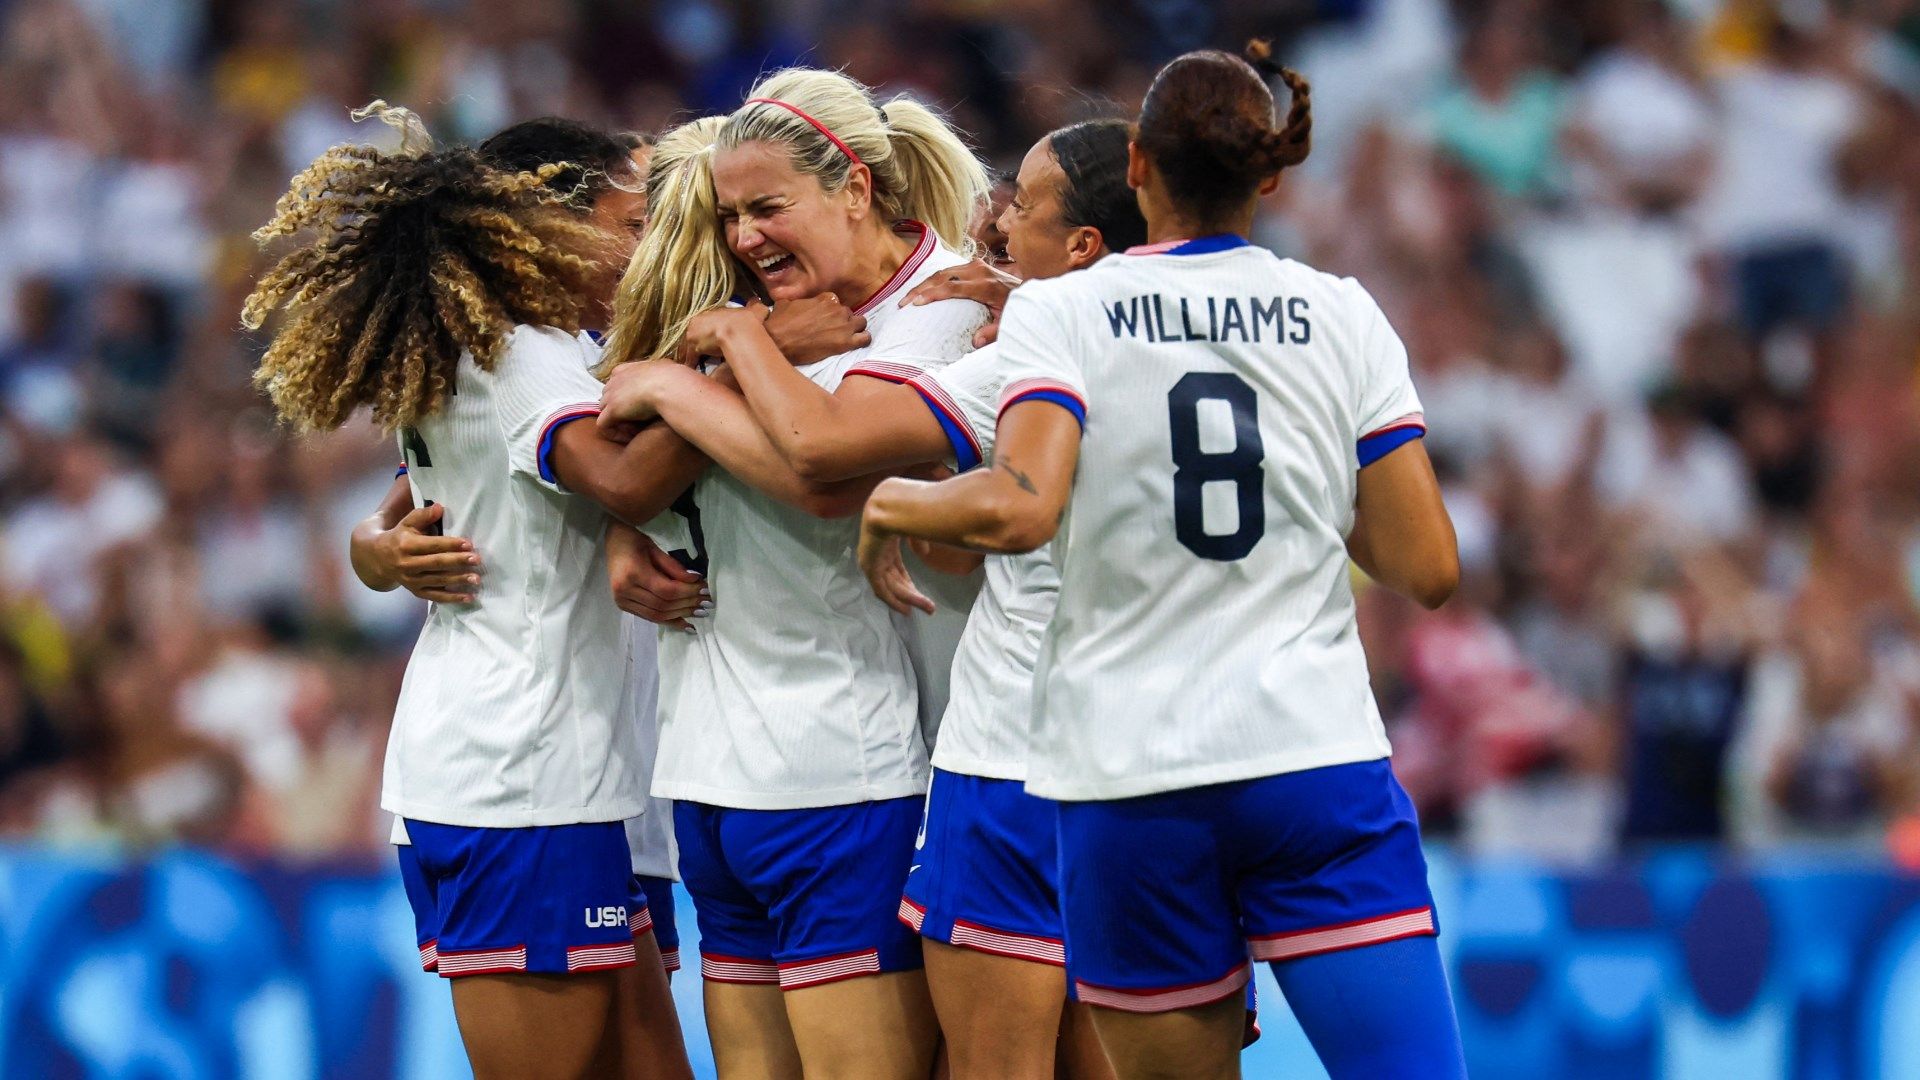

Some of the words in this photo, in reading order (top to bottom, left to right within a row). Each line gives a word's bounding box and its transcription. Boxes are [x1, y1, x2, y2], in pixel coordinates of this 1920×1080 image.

[1102, 293, 1310, 345] WILLIAMS
[1168, 372, 1265, 562] 8
[585, 906, 628, 928] USA
